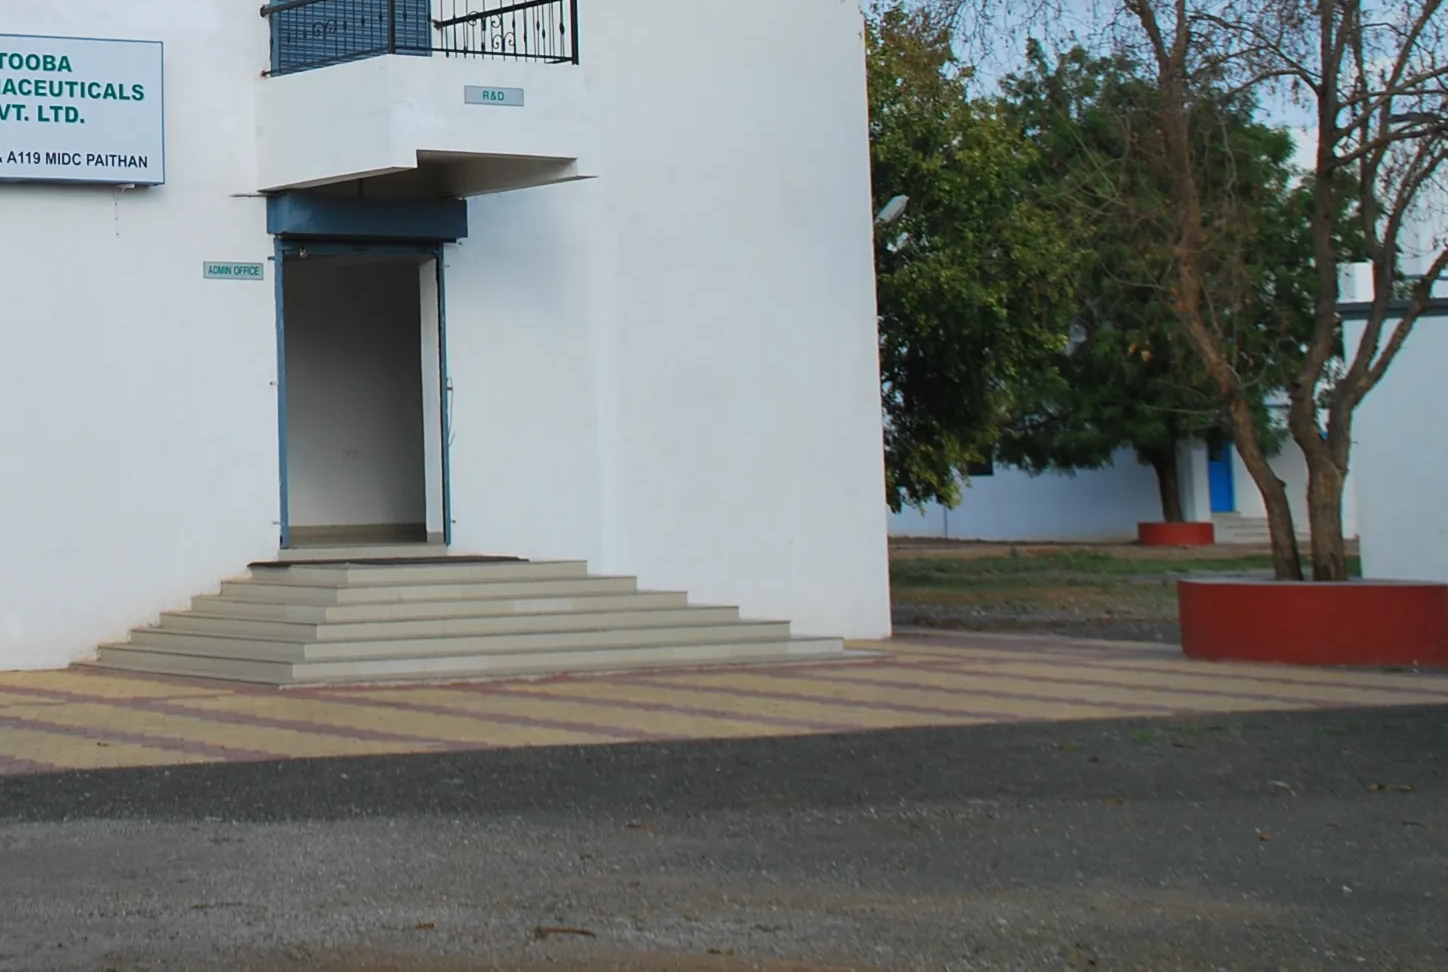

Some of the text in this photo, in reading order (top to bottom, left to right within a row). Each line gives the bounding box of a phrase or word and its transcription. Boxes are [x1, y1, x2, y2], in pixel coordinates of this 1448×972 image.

[482, 90, 505, 101] R&D
[37, 105, 85, 124] LTD.
[7, 151, 41, 165] A119
[45, 152, 82, 166] MIDC
[86, 153, 148, 169] PAITHAN
[208, 265, 260, 276] ADMIN OFFICE
